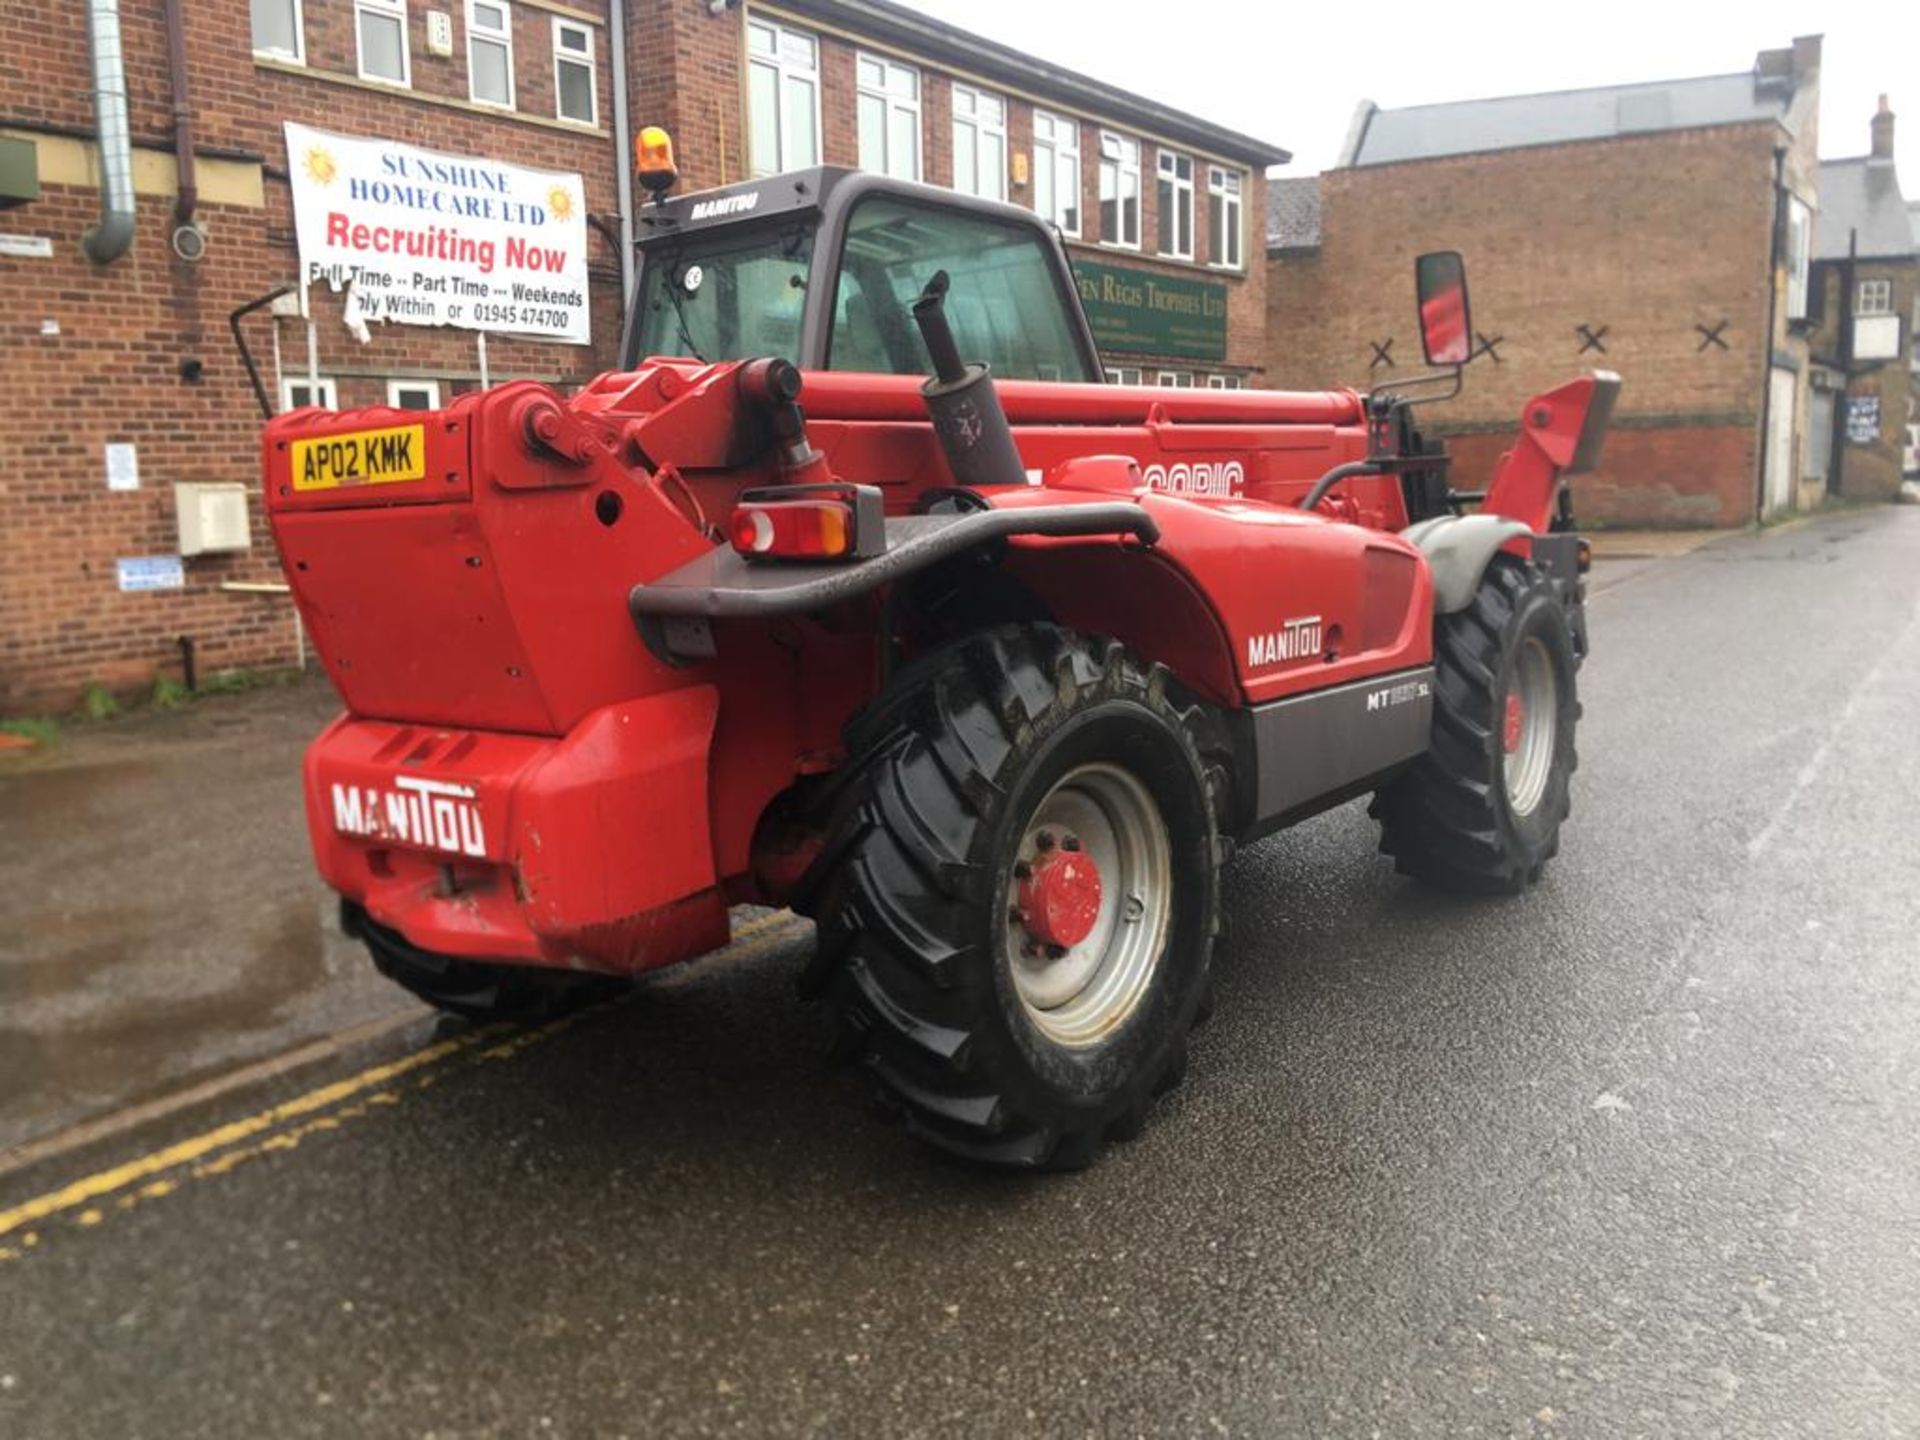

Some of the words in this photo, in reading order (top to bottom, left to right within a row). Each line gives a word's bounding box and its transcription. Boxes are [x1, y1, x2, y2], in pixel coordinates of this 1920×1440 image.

[382, 154, 511, 194] SUNSHINE
[349, 178, 496, 220] HOMECARE
[503, 201, 545, 226] LTD
[691, 192, 758, 220] MANITOU
[326, 211, 495, 273] Recruiting
[505, 237, 566, 273] Now
[309, 262, 343, 282] Full
[349, 265, 392, 287] Time
[412, 272, 447, 294] Part
[451, 276, 489, 297] Time
[512, 282, 583, 307] Weekends
[385, 295, 436, 316] Within
[447, 305, 463, 319] or
[473, 302, 517, 324] 01945
[520, 307, 569, 329] 474700
[304, 440, 359, 481] AP02
[365, 433, 412, 474] KMK
[1248, 615, 1322, 667] MANITOU
[331, 775, 487, 857] MANITOU
